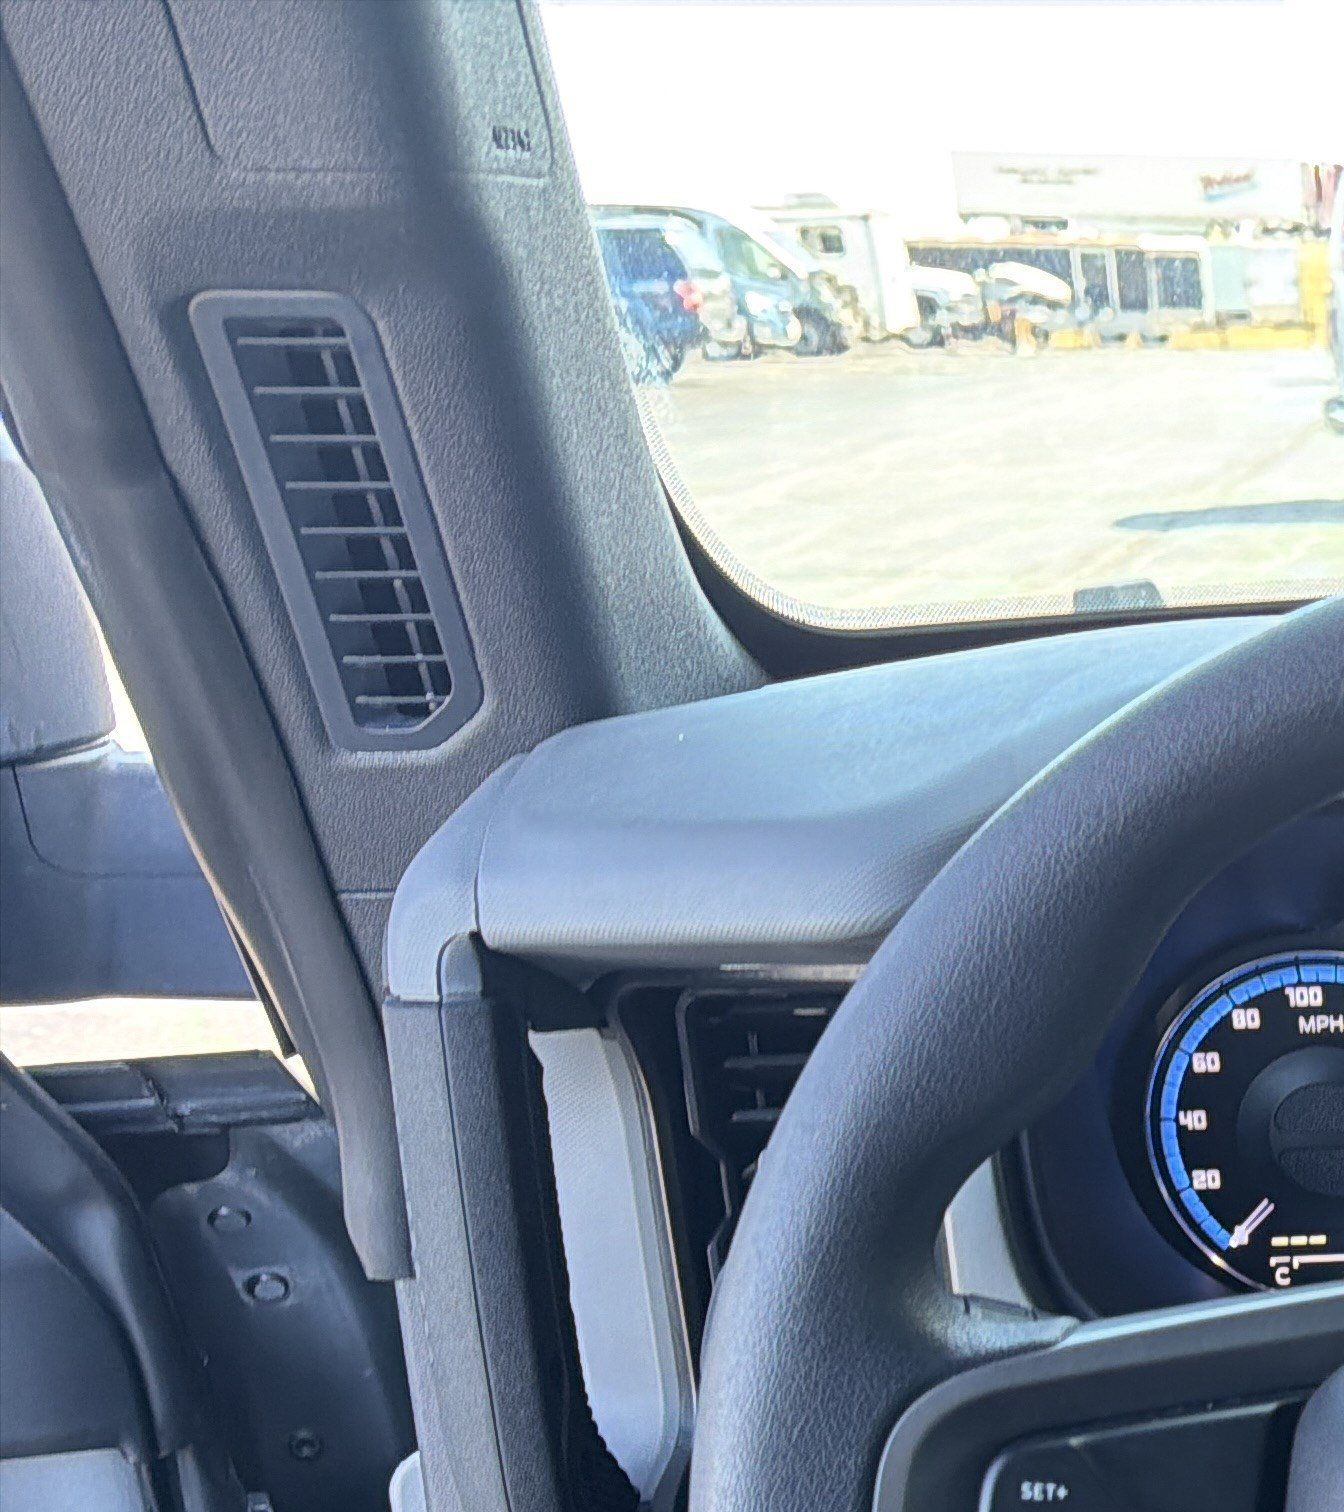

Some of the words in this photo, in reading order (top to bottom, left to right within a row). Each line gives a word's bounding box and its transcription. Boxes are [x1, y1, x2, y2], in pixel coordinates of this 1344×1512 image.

[1285, 986, 1323, 1008] 100
[1231, 1007, 1261, 1030] 80
[1298, 1014, 1344, 1034] MPH
[1192, 1052, 1221, 1073] 60
[1178, 1109, 1208, 1131] 40
[1192, 1168, 1221, 1190] 20
[1274, 1267, 1291, 1285] C
[1020, 1481, 1069, 1501] SET+
